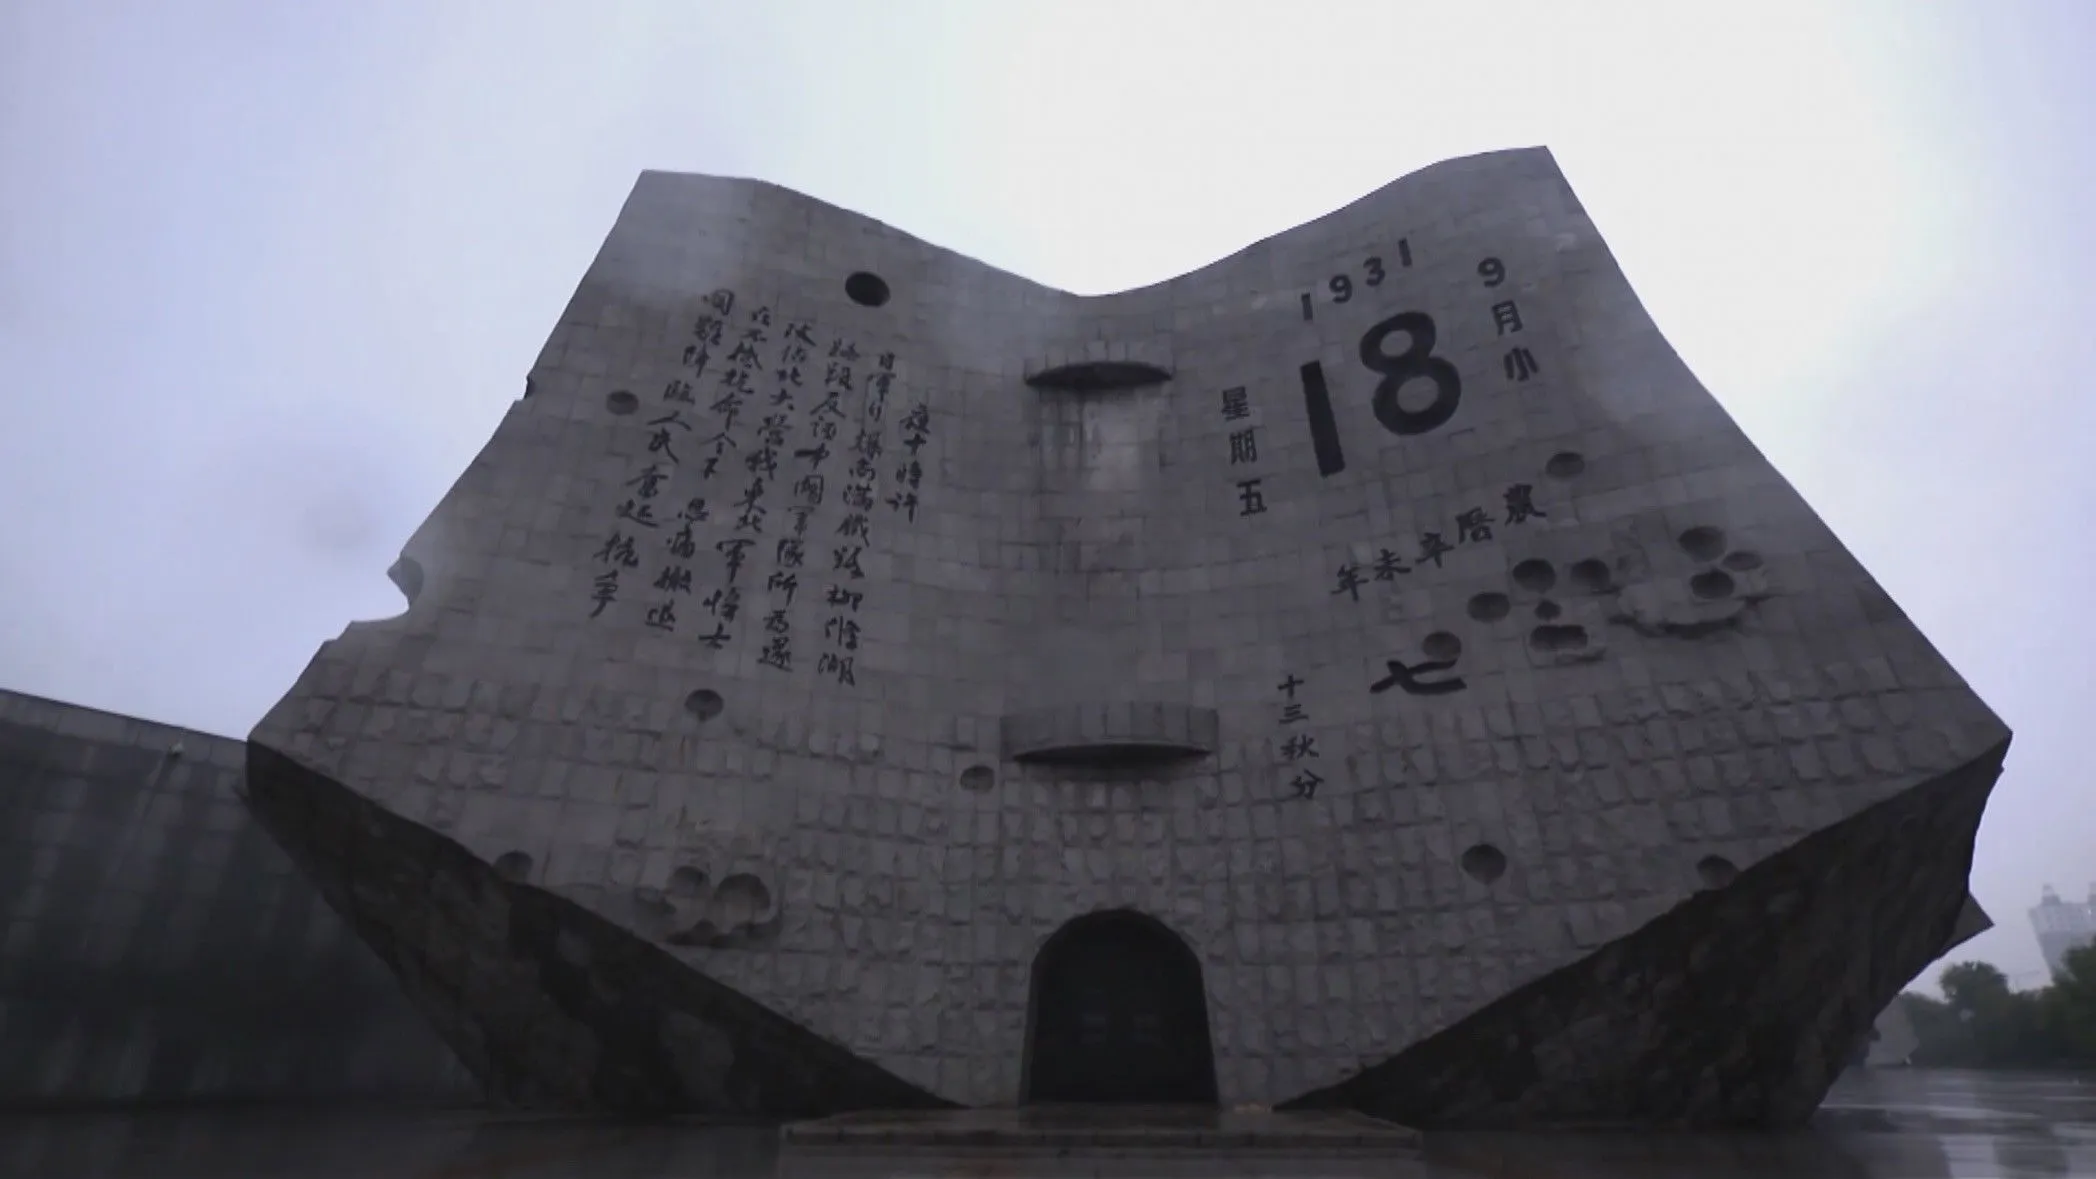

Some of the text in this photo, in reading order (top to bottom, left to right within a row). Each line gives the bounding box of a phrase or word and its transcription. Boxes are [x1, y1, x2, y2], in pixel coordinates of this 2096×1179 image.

[1301, 238, 1412, 321] 1931
[1221, 386, 1267, 516] 星期五
[1300, 311, 1461, 477] 18
[1278, 674, 1325, 800] 十三秋分
